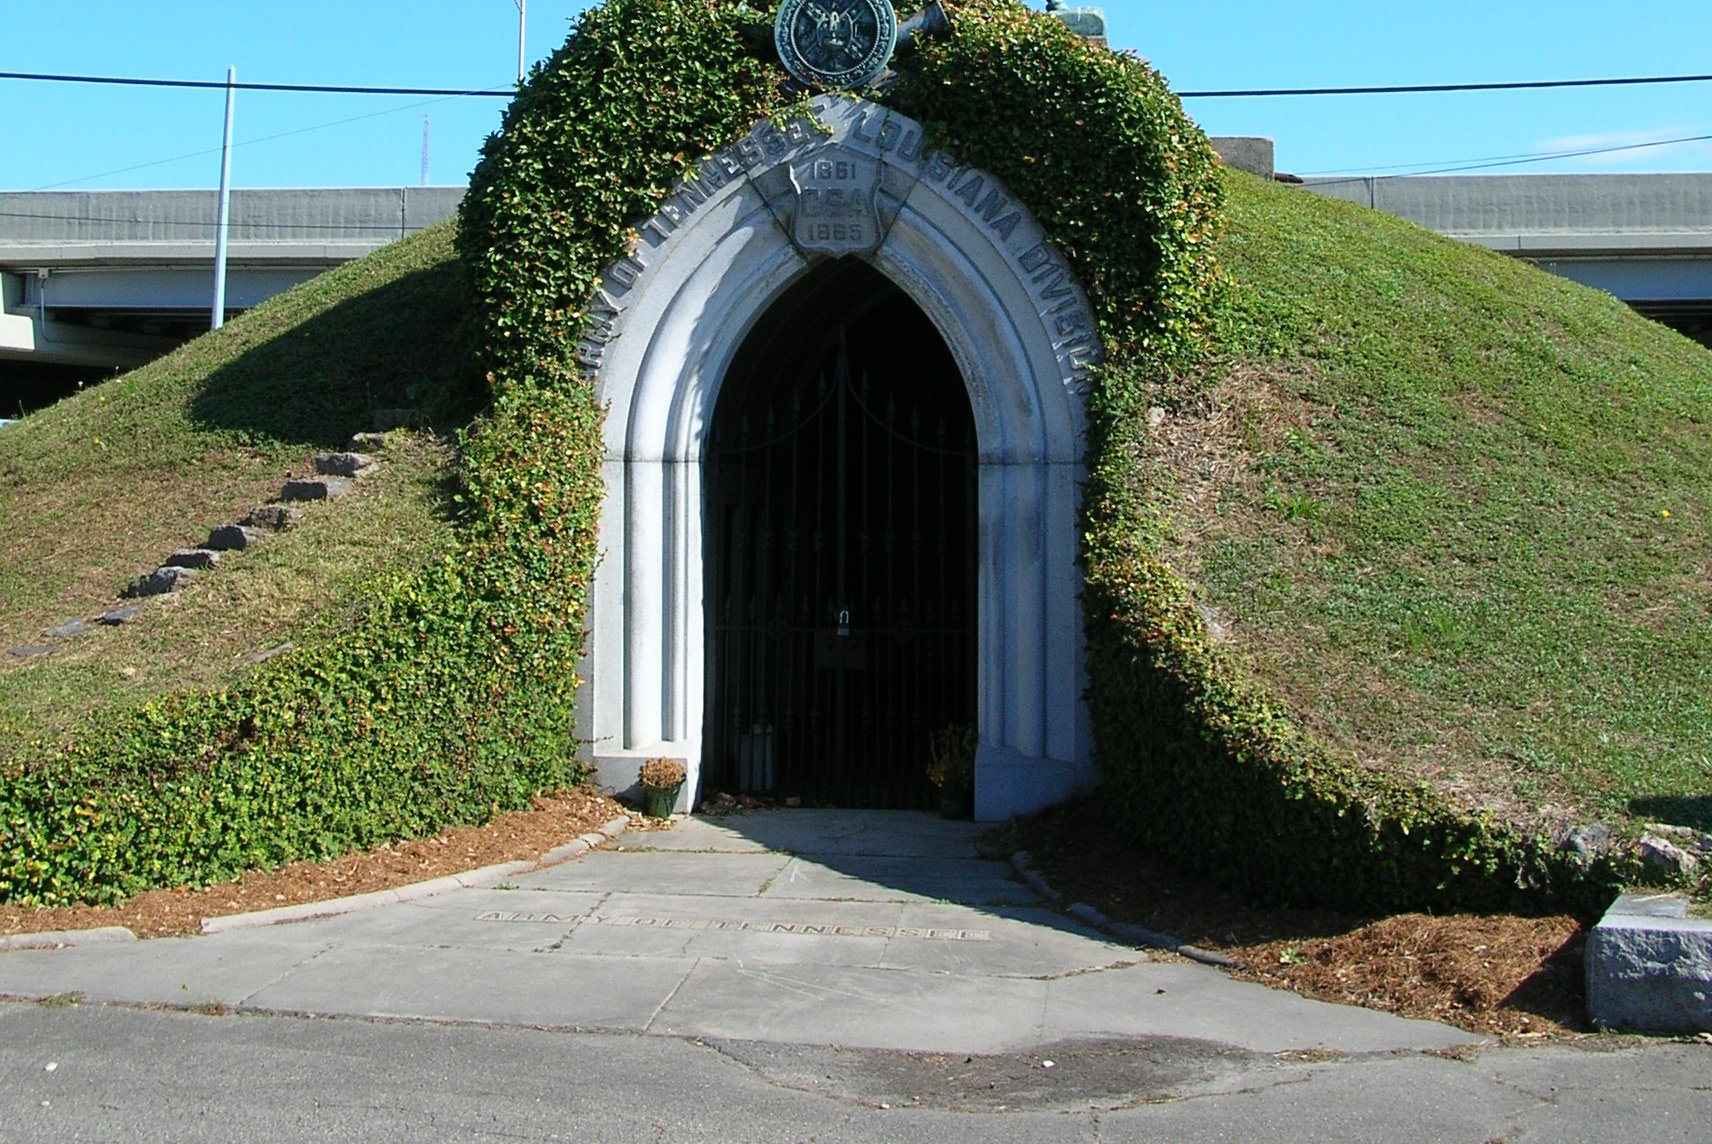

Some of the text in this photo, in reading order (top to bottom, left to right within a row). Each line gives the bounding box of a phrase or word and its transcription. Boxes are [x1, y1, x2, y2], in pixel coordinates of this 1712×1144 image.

[812, 160, 857, 181] 1861
[853, 111, 1022, 243] LOUSIANA
[801, 187, 869, 218] CSA
[807, 223, 862, 242] 1865
